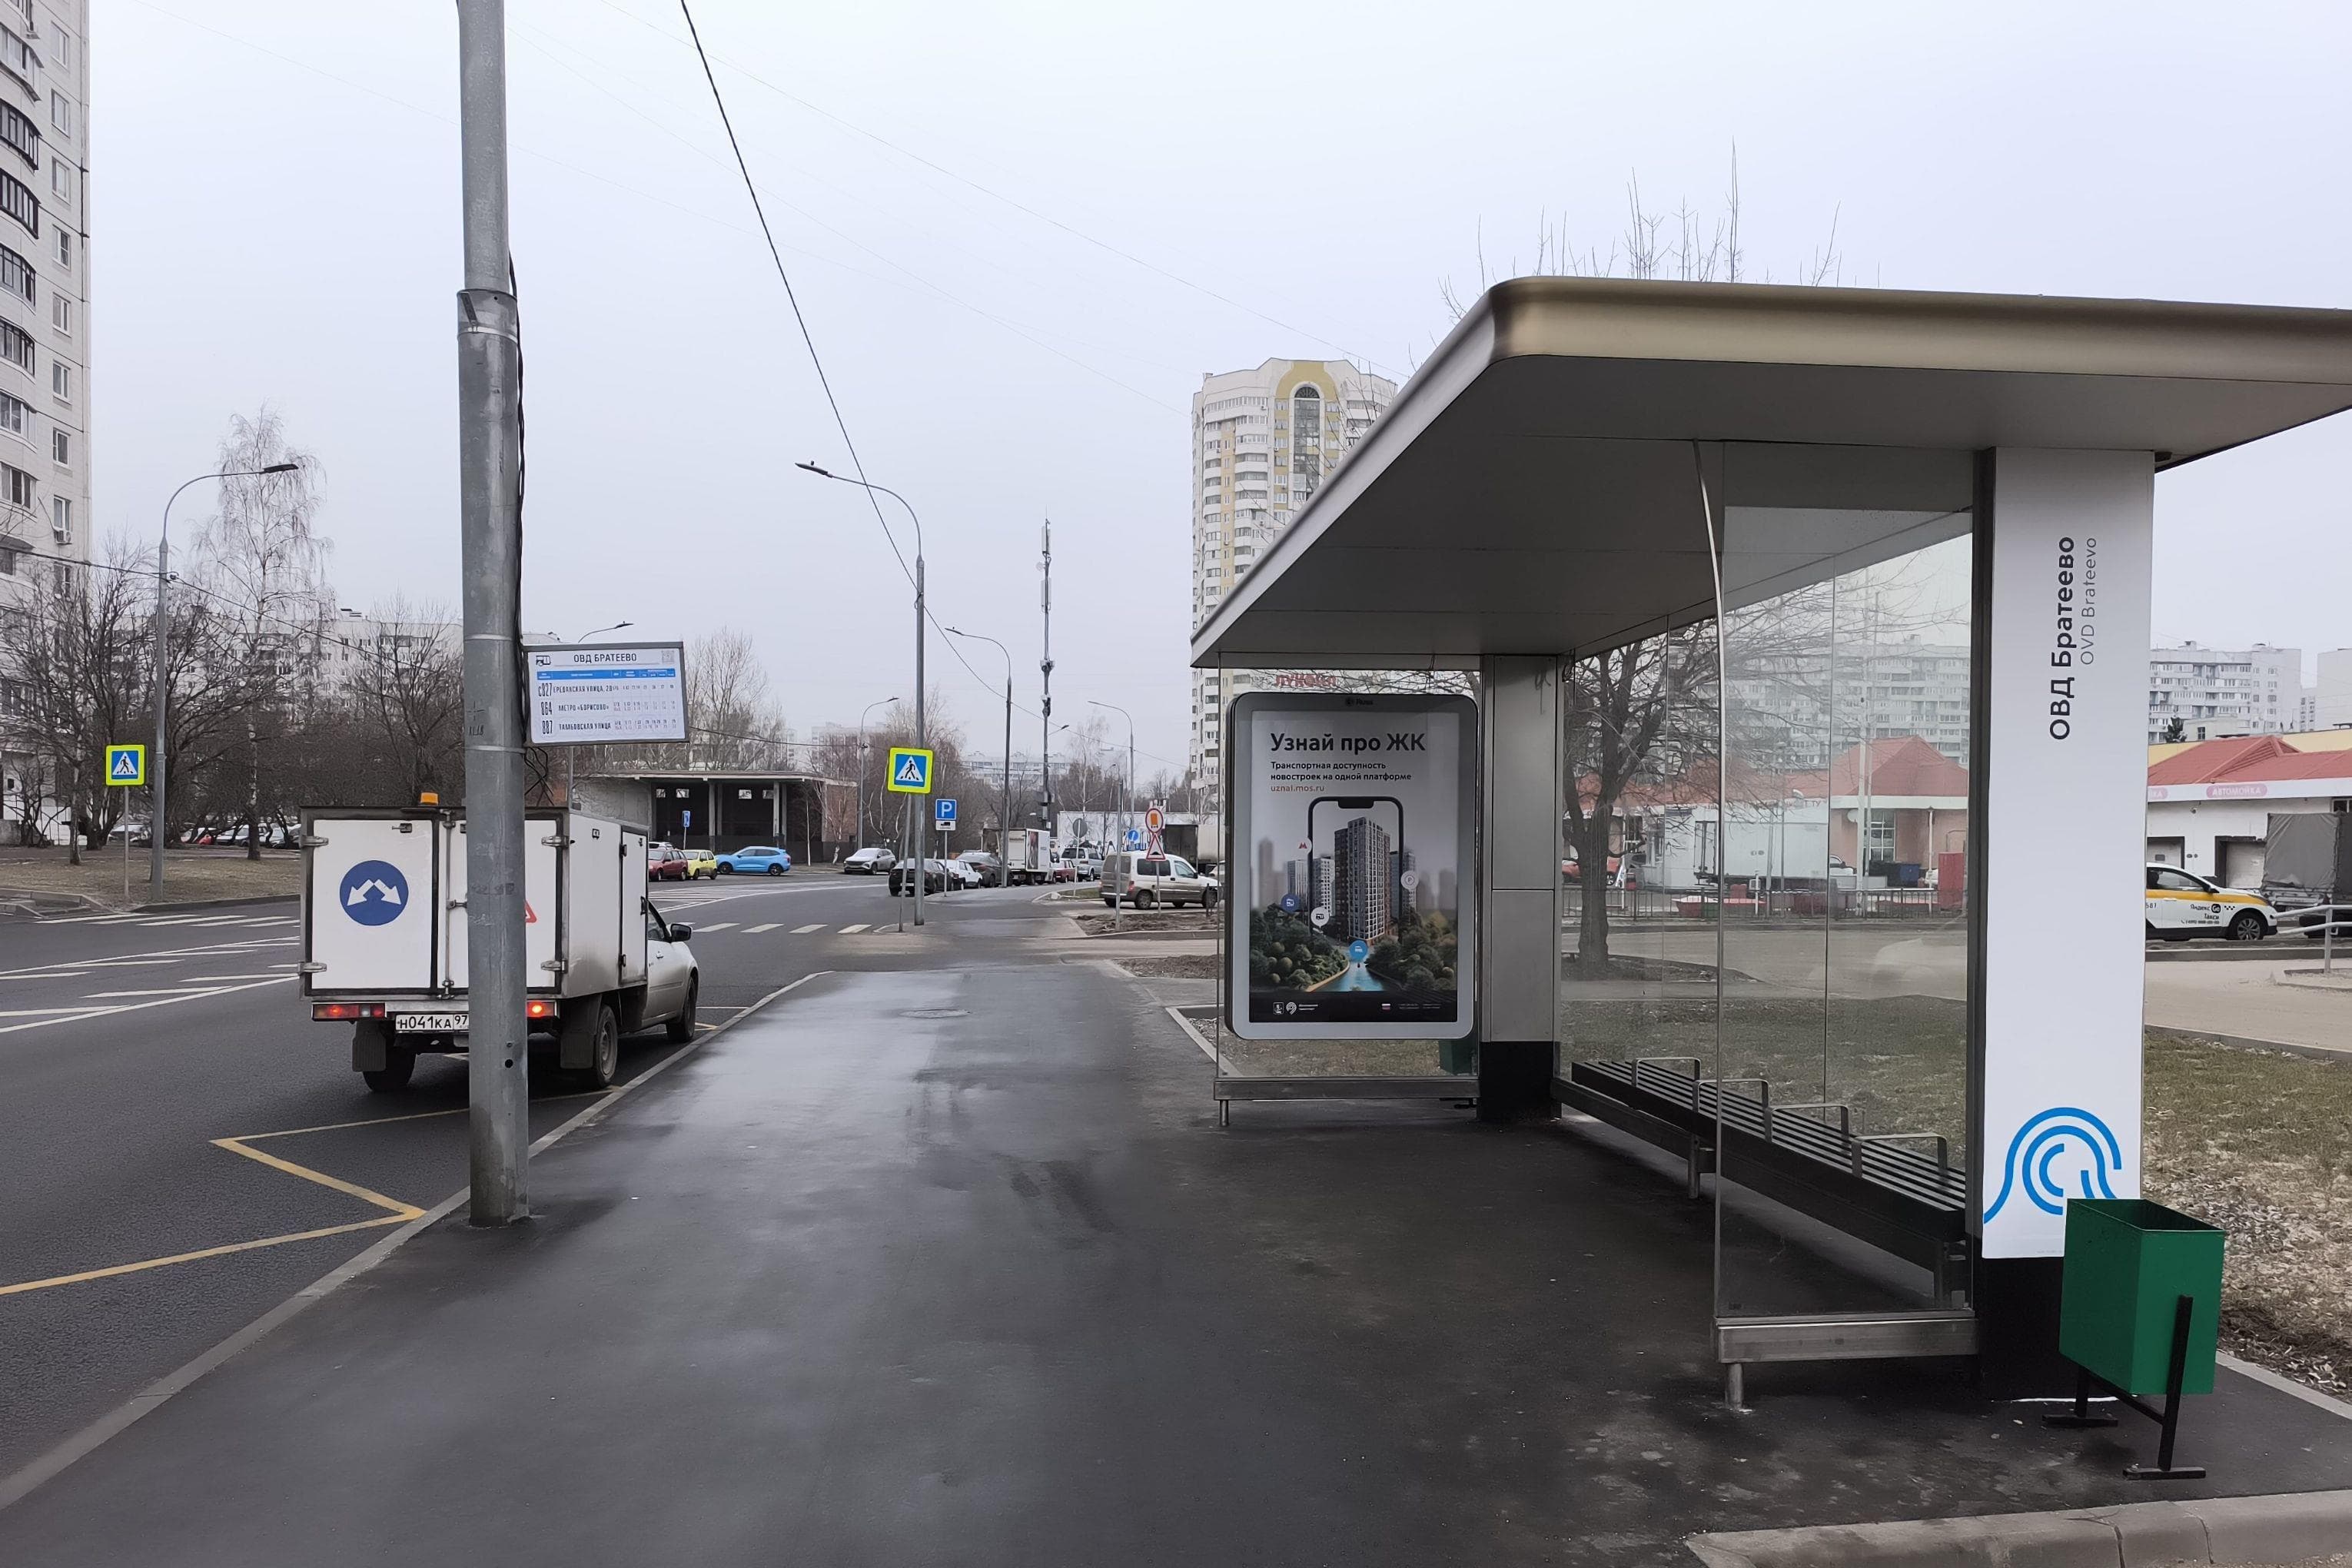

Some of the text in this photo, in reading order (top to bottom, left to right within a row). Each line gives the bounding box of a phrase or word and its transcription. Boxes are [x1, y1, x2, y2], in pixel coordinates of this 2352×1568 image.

[2080, 538, 2097, 665] OVD Brateevo
[2049, 537, 2077, 740] ОВД Братеево
[573, 653, 637, 663] ОВД БРАТЕЕВО
[540, 701, 553, 716] 864
[1270, 733, 1426, 756] Узнай про ЖК
[1270, 761, 1331, 770] Транспортная
[1334, 772, 1361, 781] одной
[1364, 772, 1412, 782] платформе
[400, 1015, 452, 1029] Н041КА
